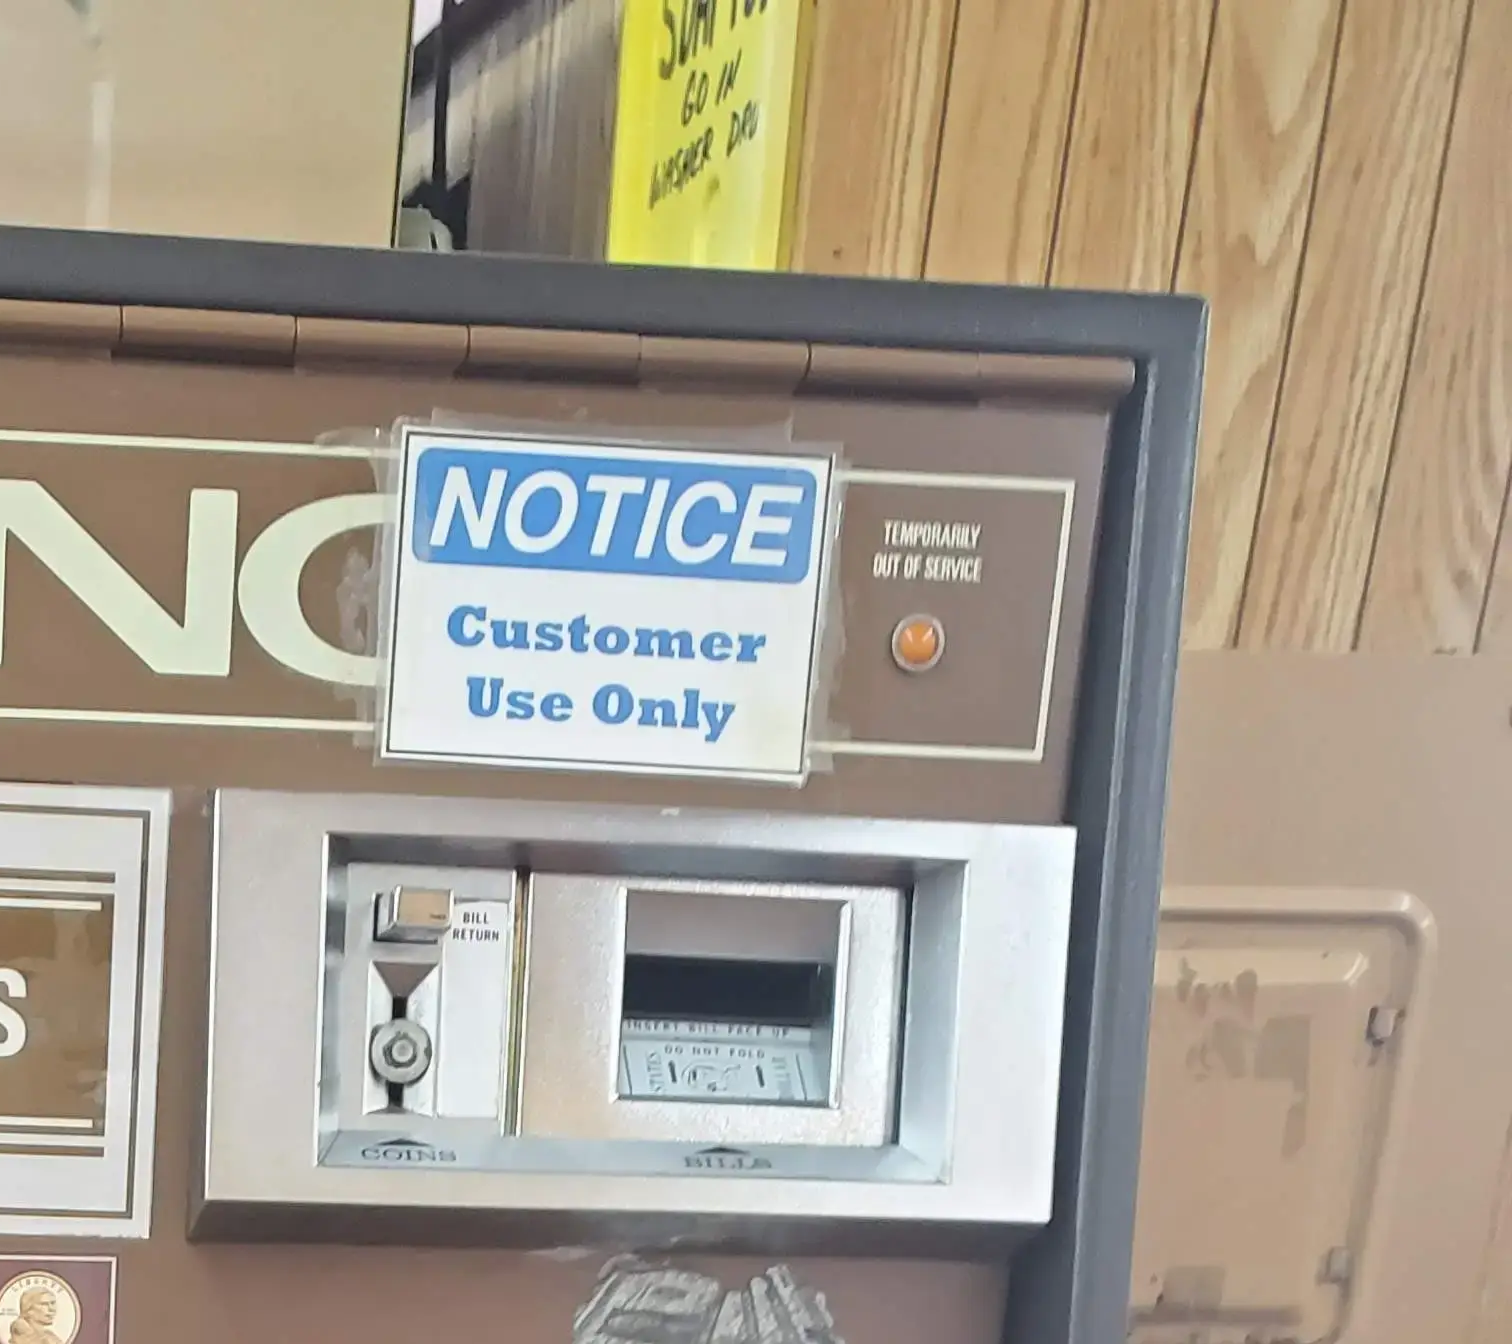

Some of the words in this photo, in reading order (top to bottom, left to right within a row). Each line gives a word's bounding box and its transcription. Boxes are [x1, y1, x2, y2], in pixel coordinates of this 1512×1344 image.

[680, 70, 709, 126] GO
[714, 48, 742, 106] IN
[429, 465, 806, 568] NOTICE
[884, 519, 981, 548] TEMPORARILY
[872, 553, 901, 578] OUT
[903, 554, 922, 579] OF
[924, 555, 982, 583] SERVICE
[446, 604, 767, 664] Customer
[466, 675, 574, 726] Use
[591, 682, 737, 743] Only
[462, 911, 489, 925] BILL
[452, 928, 500, 942] RETURN
[361, 1147, 458, 1163] COINS
